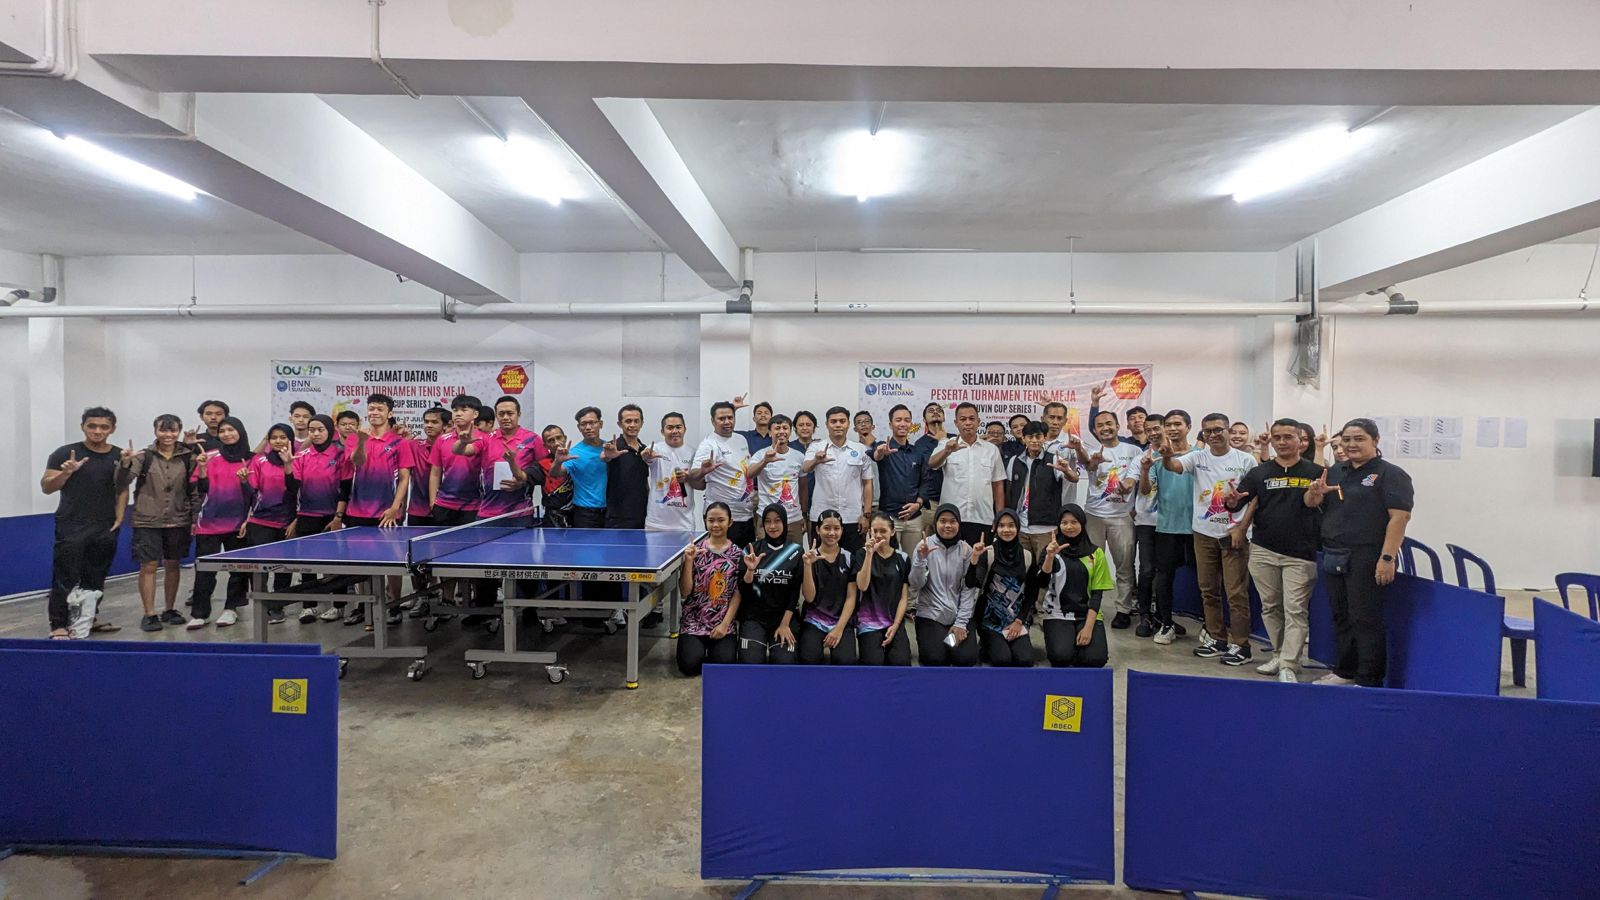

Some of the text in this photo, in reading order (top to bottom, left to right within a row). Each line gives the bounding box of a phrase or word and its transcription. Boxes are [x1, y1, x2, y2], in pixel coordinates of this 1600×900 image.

[364, 370, 438, 382] SELAMAT DATANG
[962, 373, 1045, 386] SELAMAT DATANG
[336, 385, 466, 397] PESERTA TURNAMEN TENIS MEJA
[931, 388, 1076, 402] PESERTA TURNAMEN TENIS MEJA
[393, 400, 431, 408] CUP SERIES 1
[976, 404, 1037, 413] UVIN CUP SERIES 1
[608, 573, 627, 581] 235
